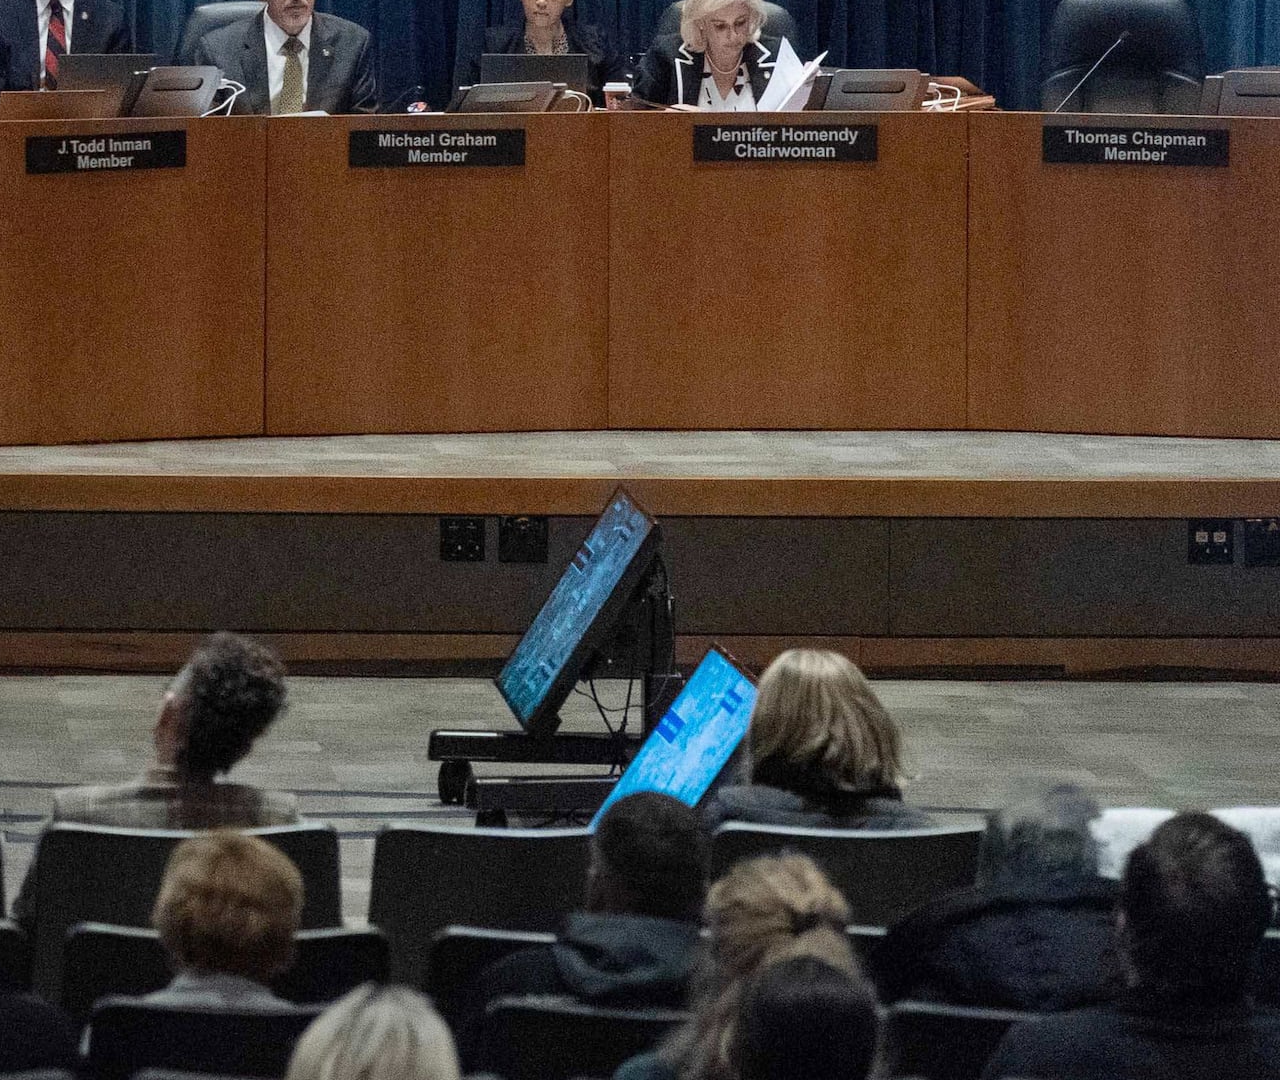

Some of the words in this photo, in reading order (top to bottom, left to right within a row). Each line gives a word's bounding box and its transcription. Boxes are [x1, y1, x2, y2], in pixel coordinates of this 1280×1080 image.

[378, 134, 435, 147] Michael
[439, 133, 497, 147] Graham
[712, 128, 777, 142] Jennifer
[781, 128, 858, 145] Homendy
[1064, 130, 1127, 144] Thomas
[1132, 131, 1207, 148] Chapman
[70, 139, 105, 154] Todd
[109, 138, 152, 153] Inman
[735, 143, 836, 158] Chairwoman
[77, 155, 134, 169] Member
[408, 149, 468, 163] Member
[1104, 147, 1167, 162] Member
